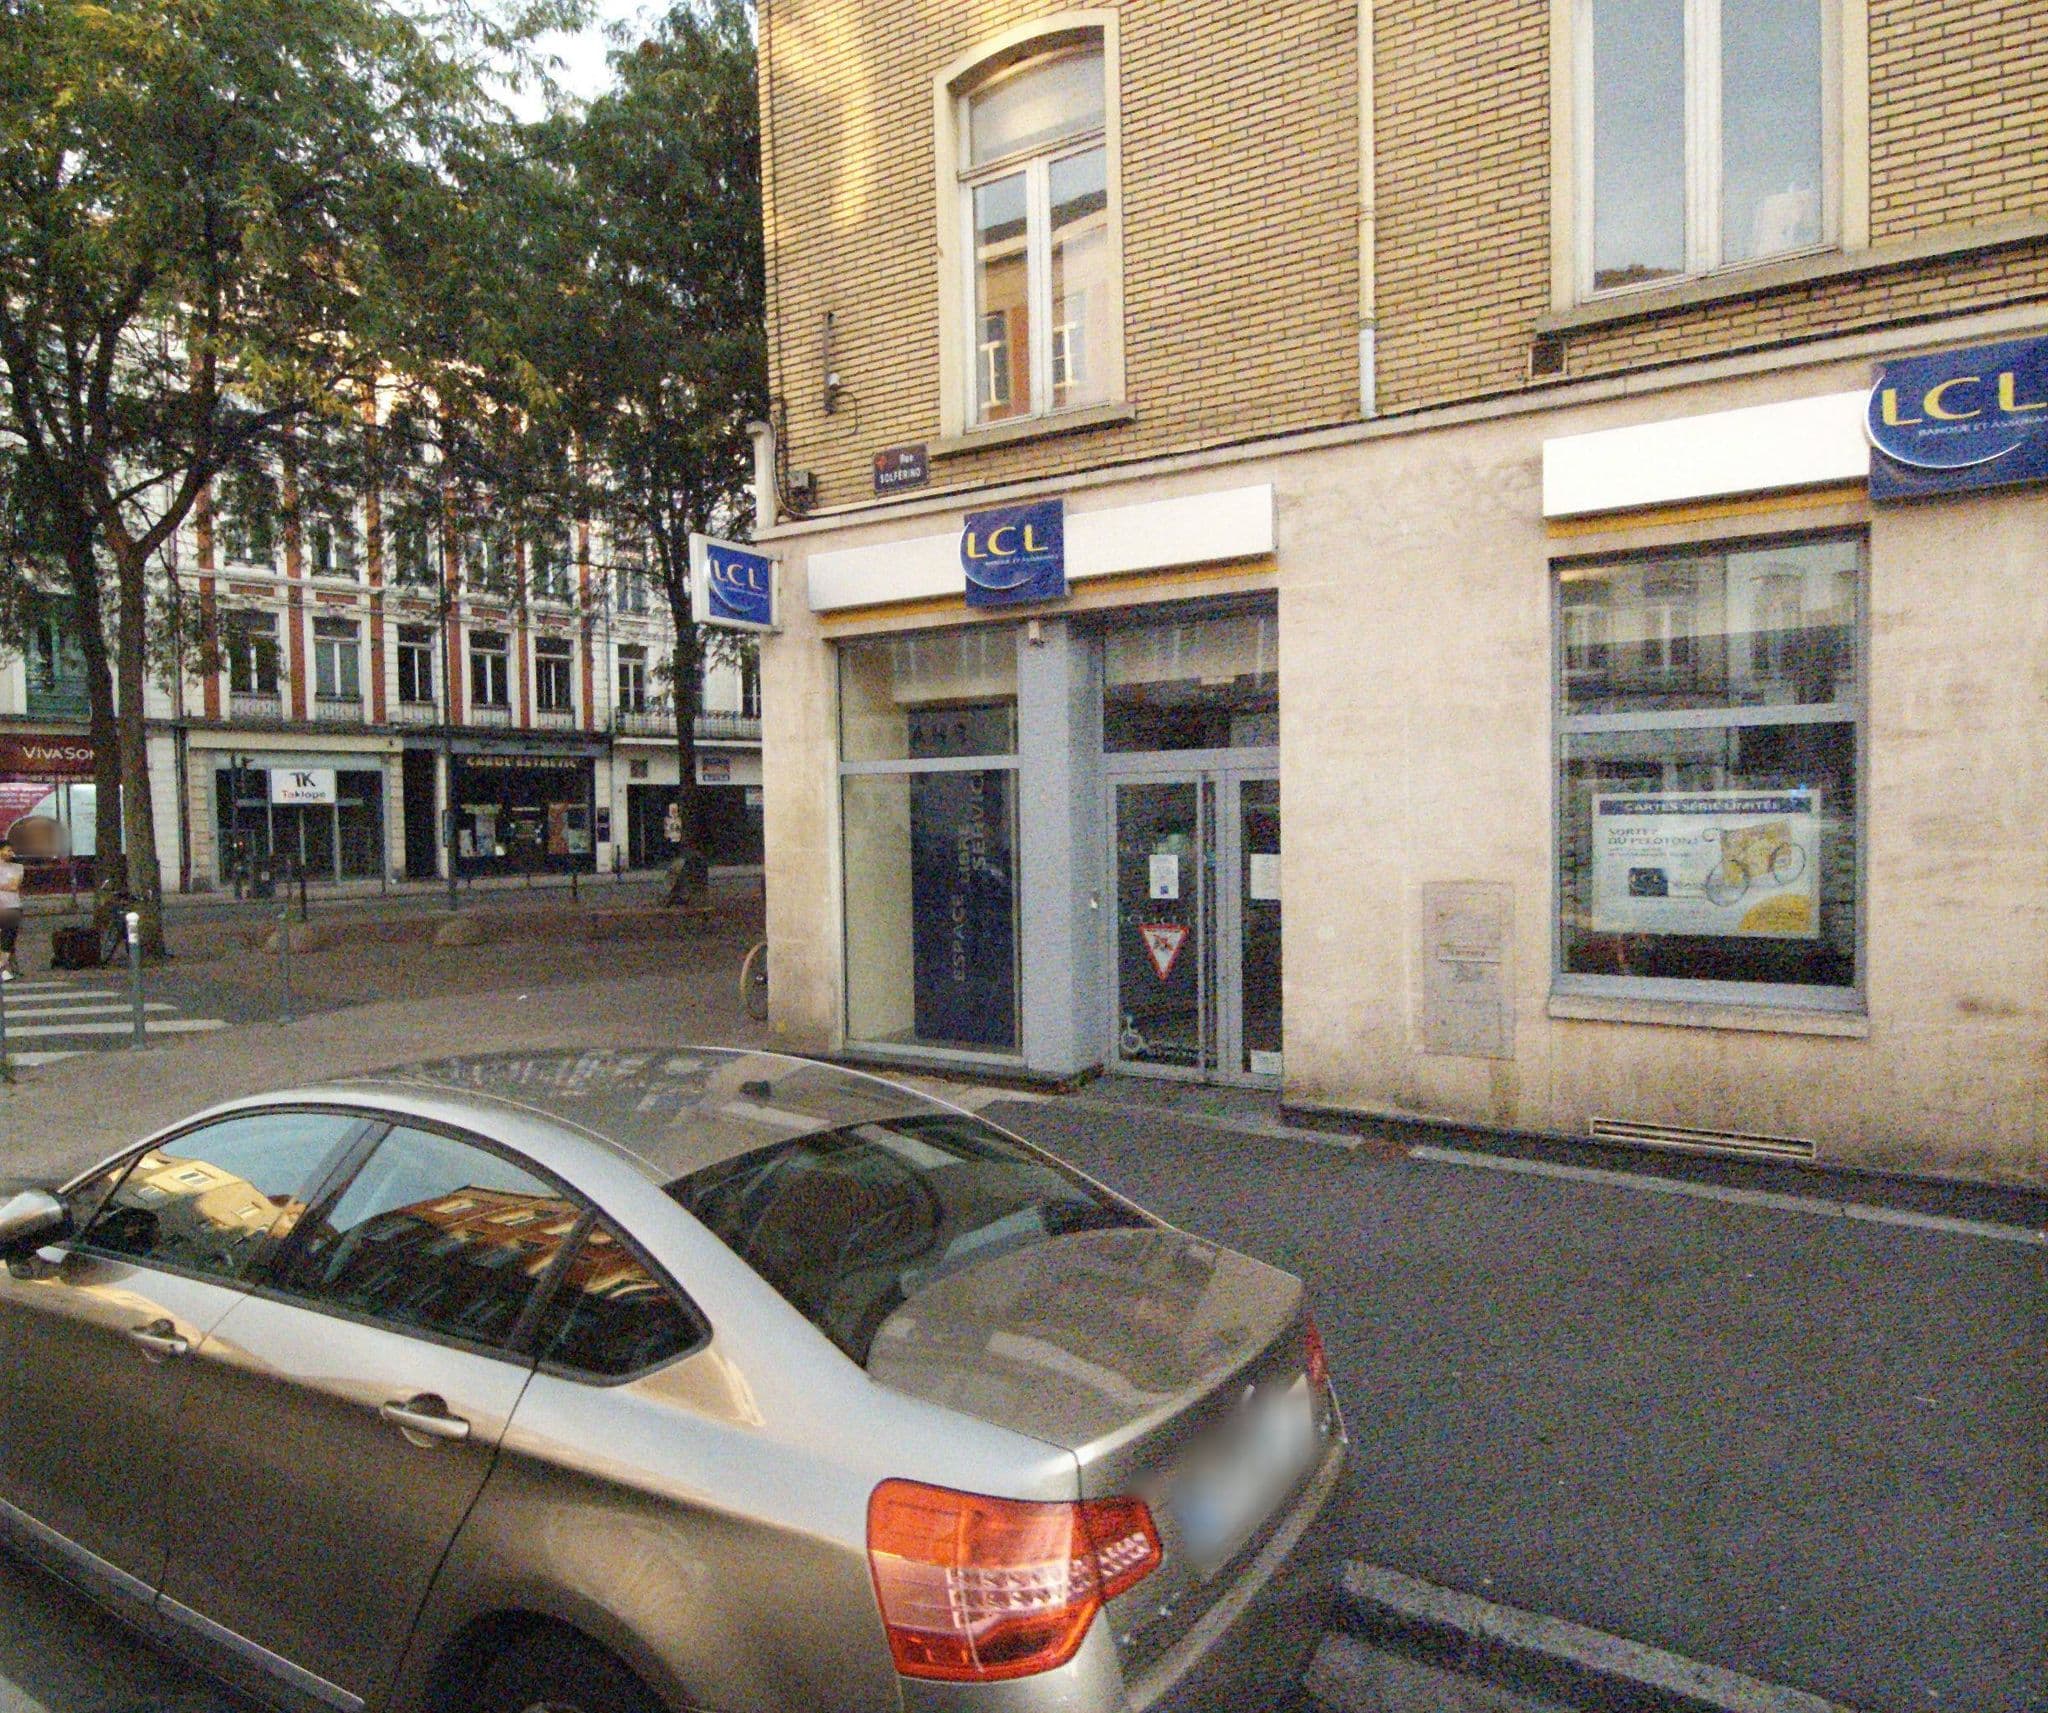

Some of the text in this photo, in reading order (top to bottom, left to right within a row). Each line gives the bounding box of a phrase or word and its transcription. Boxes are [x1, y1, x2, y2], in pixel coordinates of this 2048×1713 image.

[1882, 371, 2048, 426] LCL
[899, 453, 914, 464] Rue
[967, 523, 1049, 559] LCL
[713, 559, 764, 591] LCL
[289, 770, 317, 788] TK
